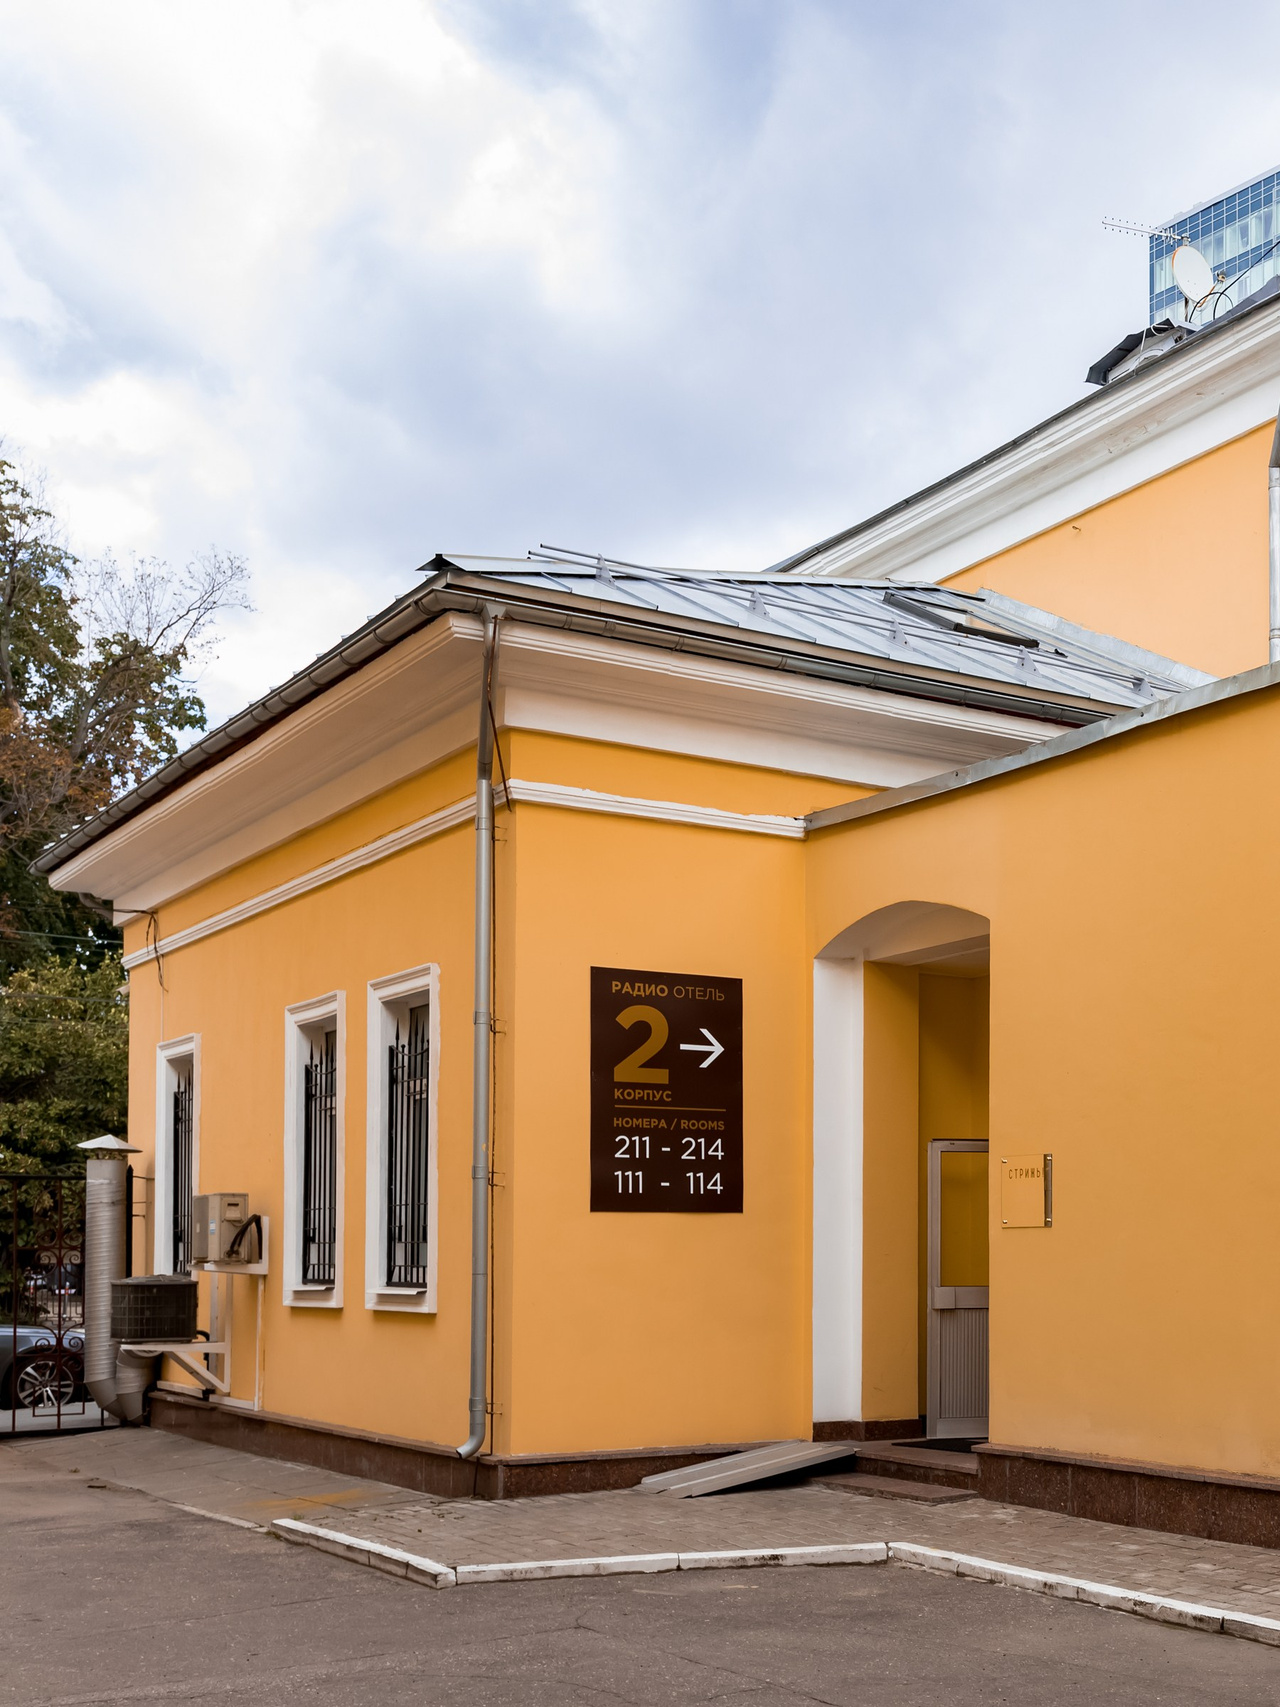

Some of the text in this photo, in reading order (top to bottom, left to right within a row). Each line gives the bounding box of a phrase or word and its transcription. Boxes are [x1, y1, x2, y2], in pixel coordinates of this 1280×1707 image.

[611, 980, 725, 1001] РАДИО ОТЕЛЬ
[613, 1004, 669, 1084] 2
[614, 1088, 672, 1102] КОРПУС
[613, 1117, 668, 1129] НОМЕРА
[680, 1119, 725, 1131] ROOMS
[614, 1135, 650, 1159] 211
[680, 1137, 725, 1160] 214
[614, 1170, 643, 1194] 111
[686, 1172, 723, 1195] 114
